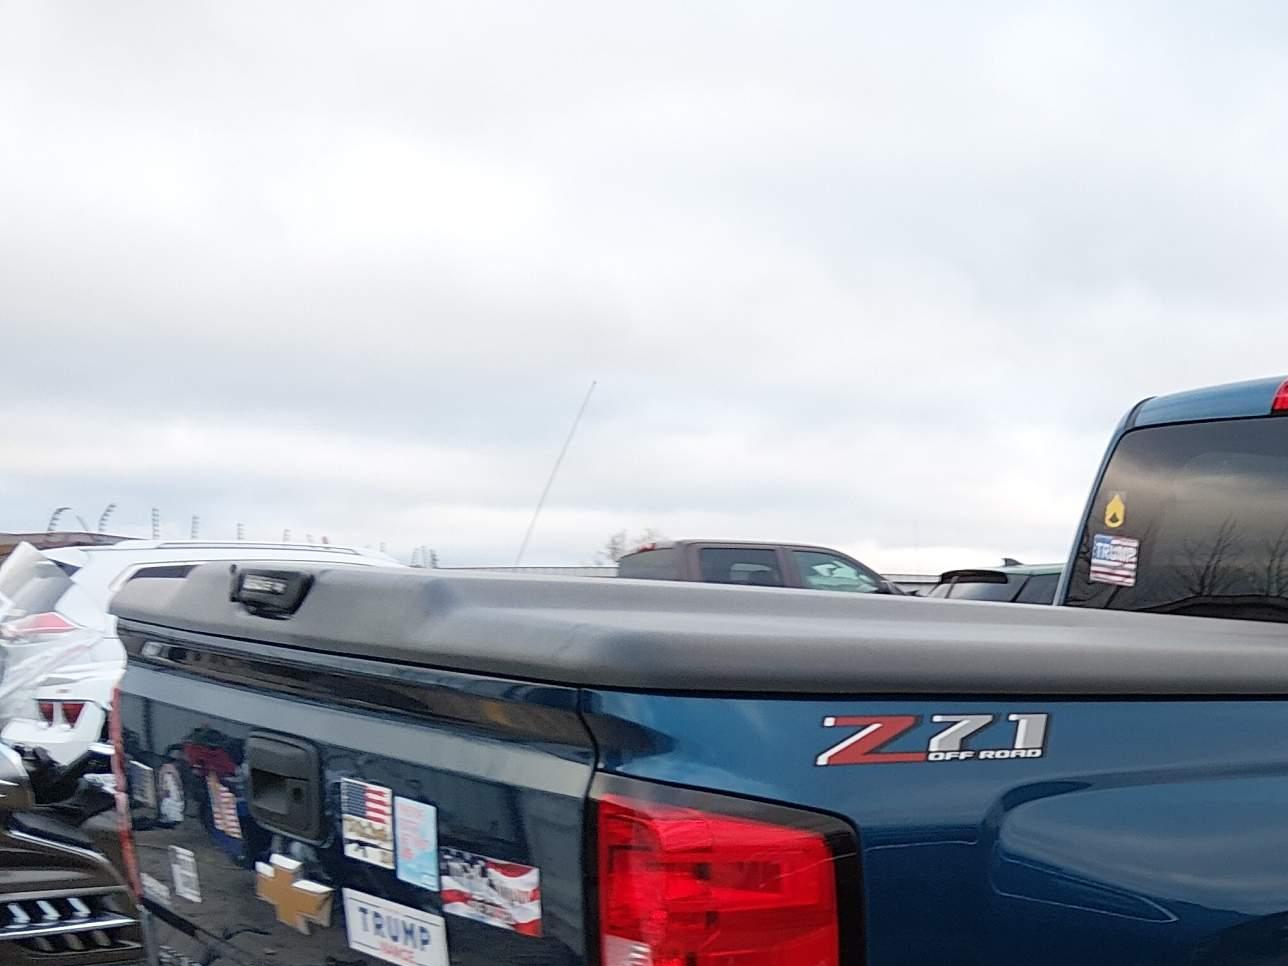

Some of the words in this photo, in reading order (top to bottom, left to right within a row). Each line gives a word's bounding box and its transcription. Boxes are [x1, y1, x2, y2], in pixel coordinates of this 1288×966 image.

[816, 713, 1049, 767] Z71
[927, 751, 975, 762] OFF
[978, 748, 1043, 761] ROAD
[358, 906, 431, 952] TRUMP
